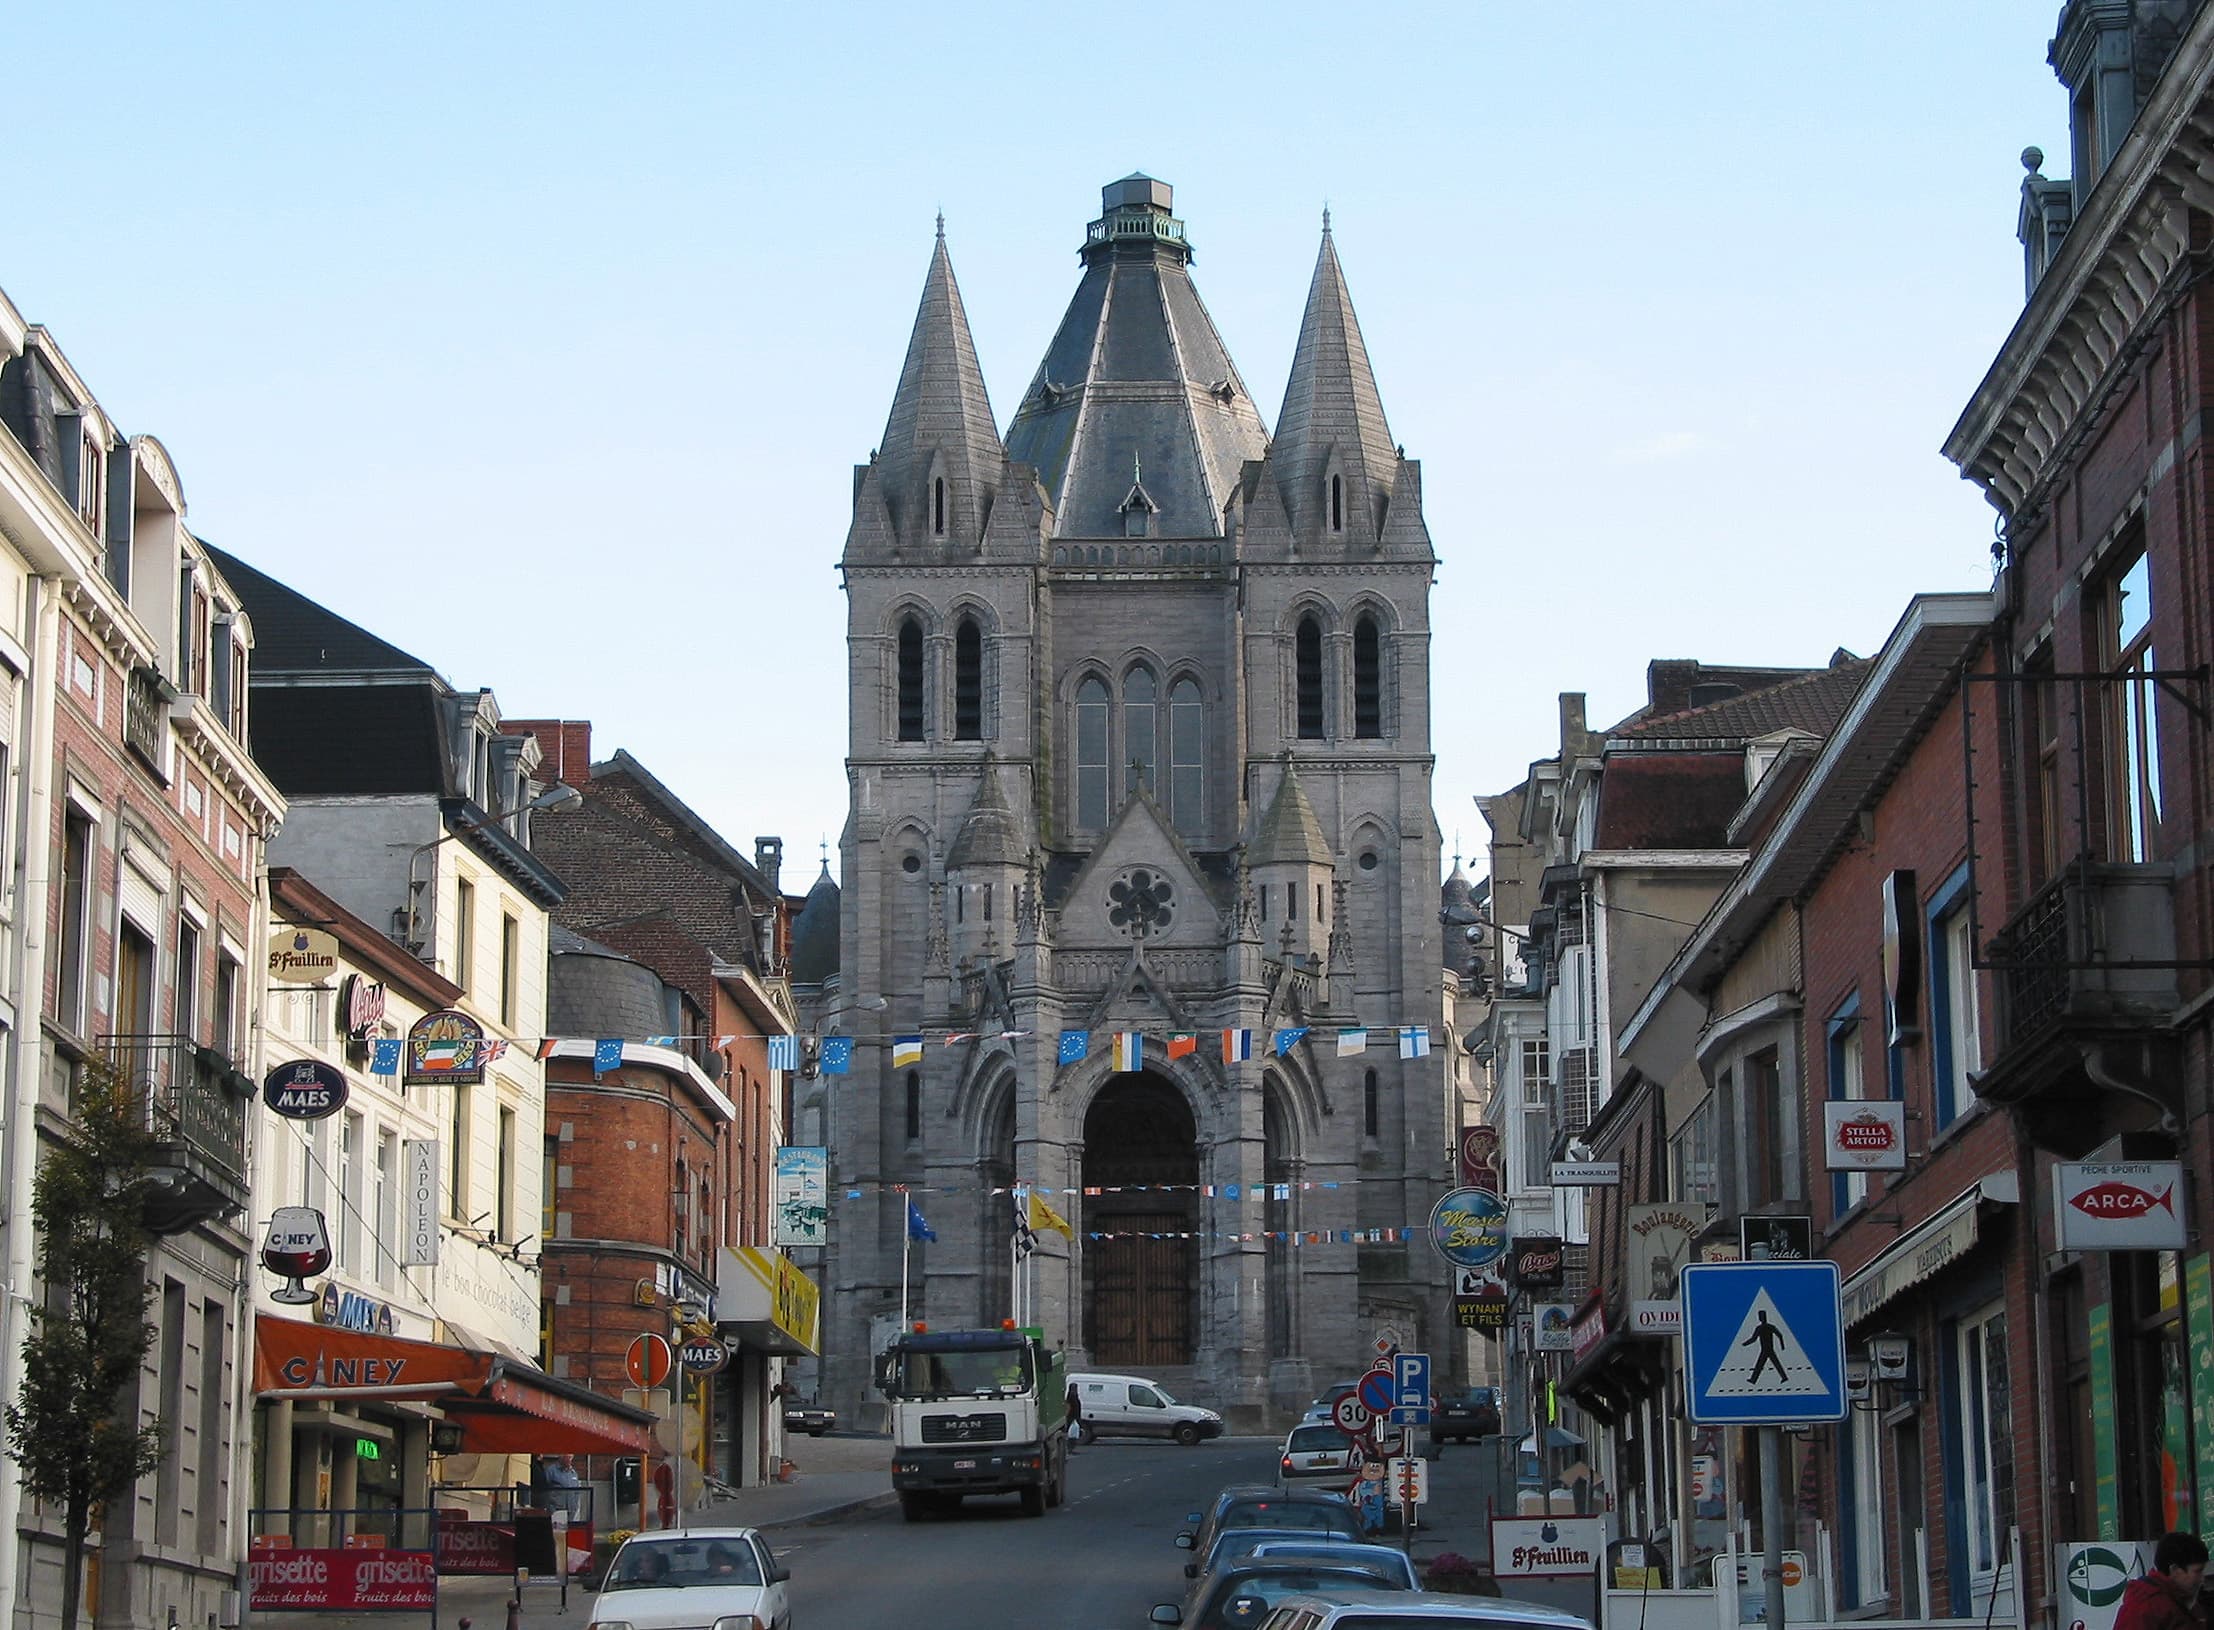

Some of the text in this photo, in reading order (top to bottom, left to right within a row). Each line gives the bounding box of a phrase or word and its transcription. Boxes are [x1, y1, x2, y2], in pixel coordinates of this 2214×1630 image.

[281, 951, 333, 972] Feuillien
[277, 1091, 330, 1107] MAES
[1846, 1127, 1886, 1136] STELLA
[1846, 1137, 1887, 1145] ARTOIS
[2111, 1165, 2151, 1174] SPORTIVE
[416, 1143, 430, 1262] NAPOLEON
[2083, 1194, 2148, 1208] ARCA
[1440, 1208, 1506, 1227] Music
[1632, 1209, 1700, 1240] Boulangerie
[1446, 1229, 1498, 1247] Store
[1519, 1250, 1560, 1274] Bass
[455, 1264, 470, 1296] bon
[1458, 1304, 1506, 1313] WYNANT
[1462, 1315, 1502, 1325] ET FILS
[682, 1349, 721, 1361] MAES
[1403, 1360, 1422, 1387] P
[1341, 1404, 1368, 1422] 30
[945, 1421, 981, 1429] MAN
[439, 1525, 499, 1551] risette
[1527, 1546, 1589, 1571] Feuillien
[249, 1552, 327, 1593] grisette
[355, 1552, 436, 1592] grisette
[250, 1590, 328, 1602] ruits des bois
[354, 1592, 390, 1602] Fruits
[393, 1590, 412, 1602] des
